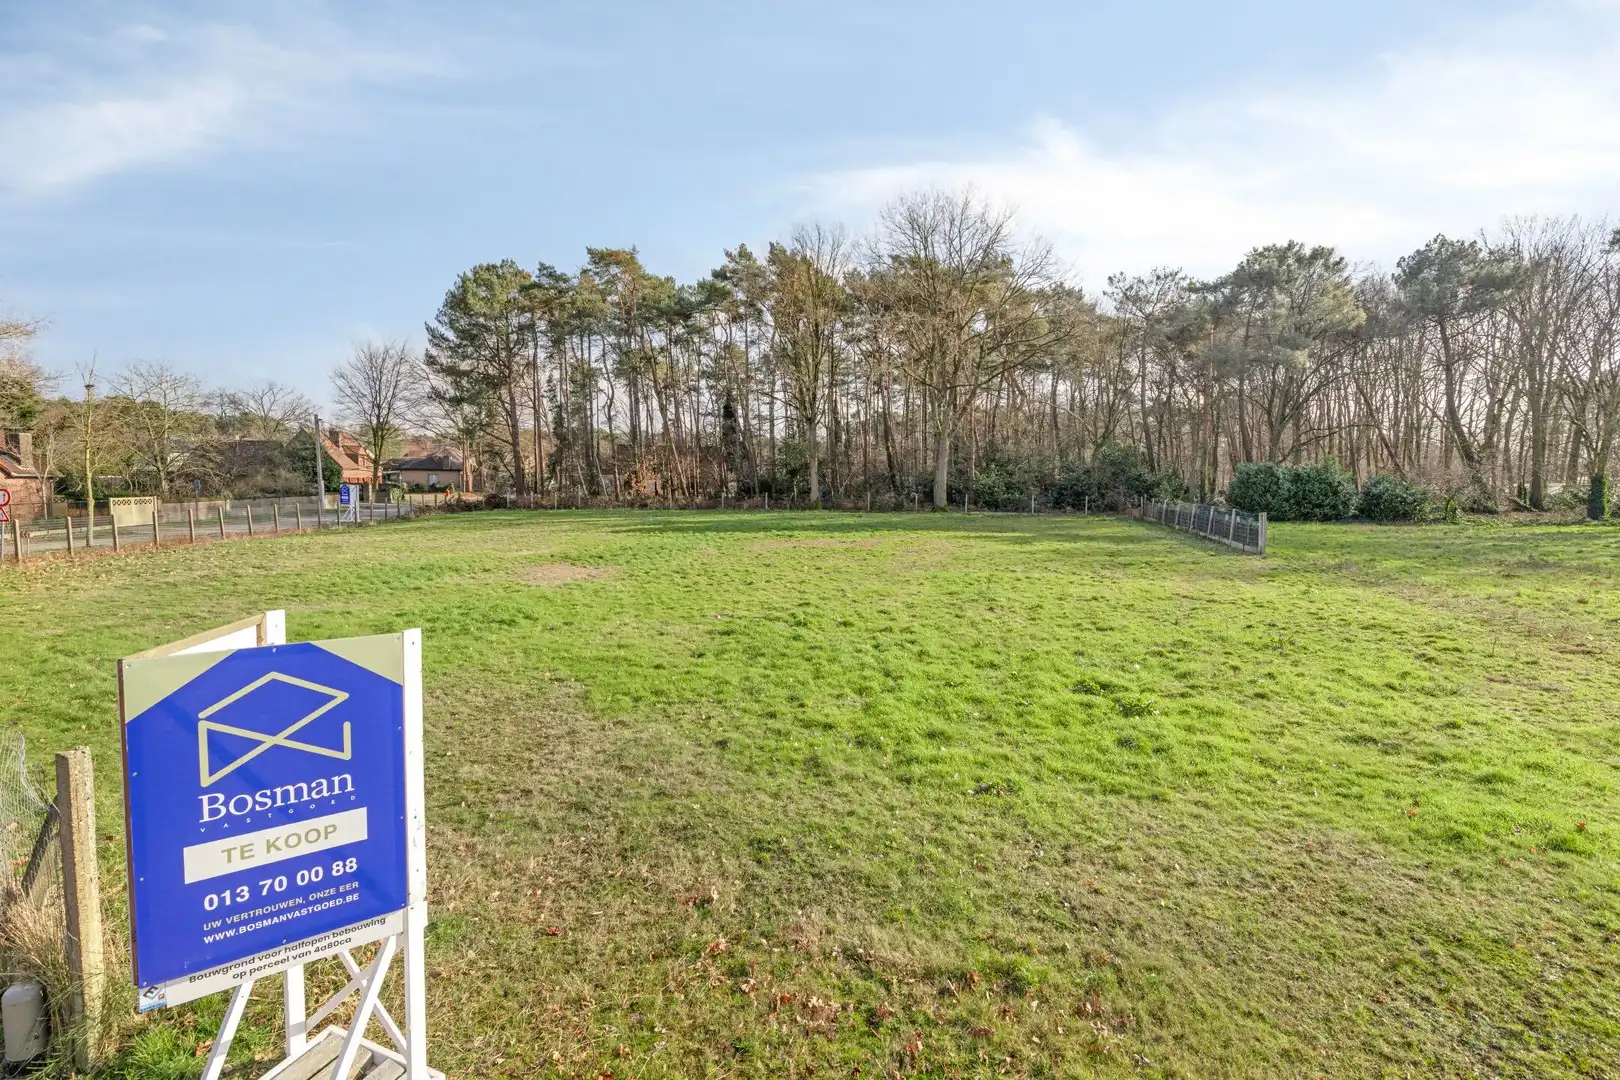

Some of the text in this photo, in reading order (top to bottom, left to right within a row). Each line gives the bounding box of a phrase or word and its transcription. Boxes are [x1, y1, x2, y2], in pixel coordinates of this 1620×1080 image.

[198, 773, 355, 823] Bosman
[200, 795, 356, 833] VASTGOED
[221, 824, 337, 864] TE KOOP
[203, 882, 360, 931] UW VERTROUWEN, ONZE EER
[204, 857, 358, 911] 013 70 00 88
[203, 893, 360, 944] WWW.BOSMANVASTGOED.BE
[189, 916, 386, 984] Bouwgrond voor halfopen bebouwing
[232, 970, 247, 980] op
[249, 956, 290, 977] perceel
[292, 949, 312, 961] van
